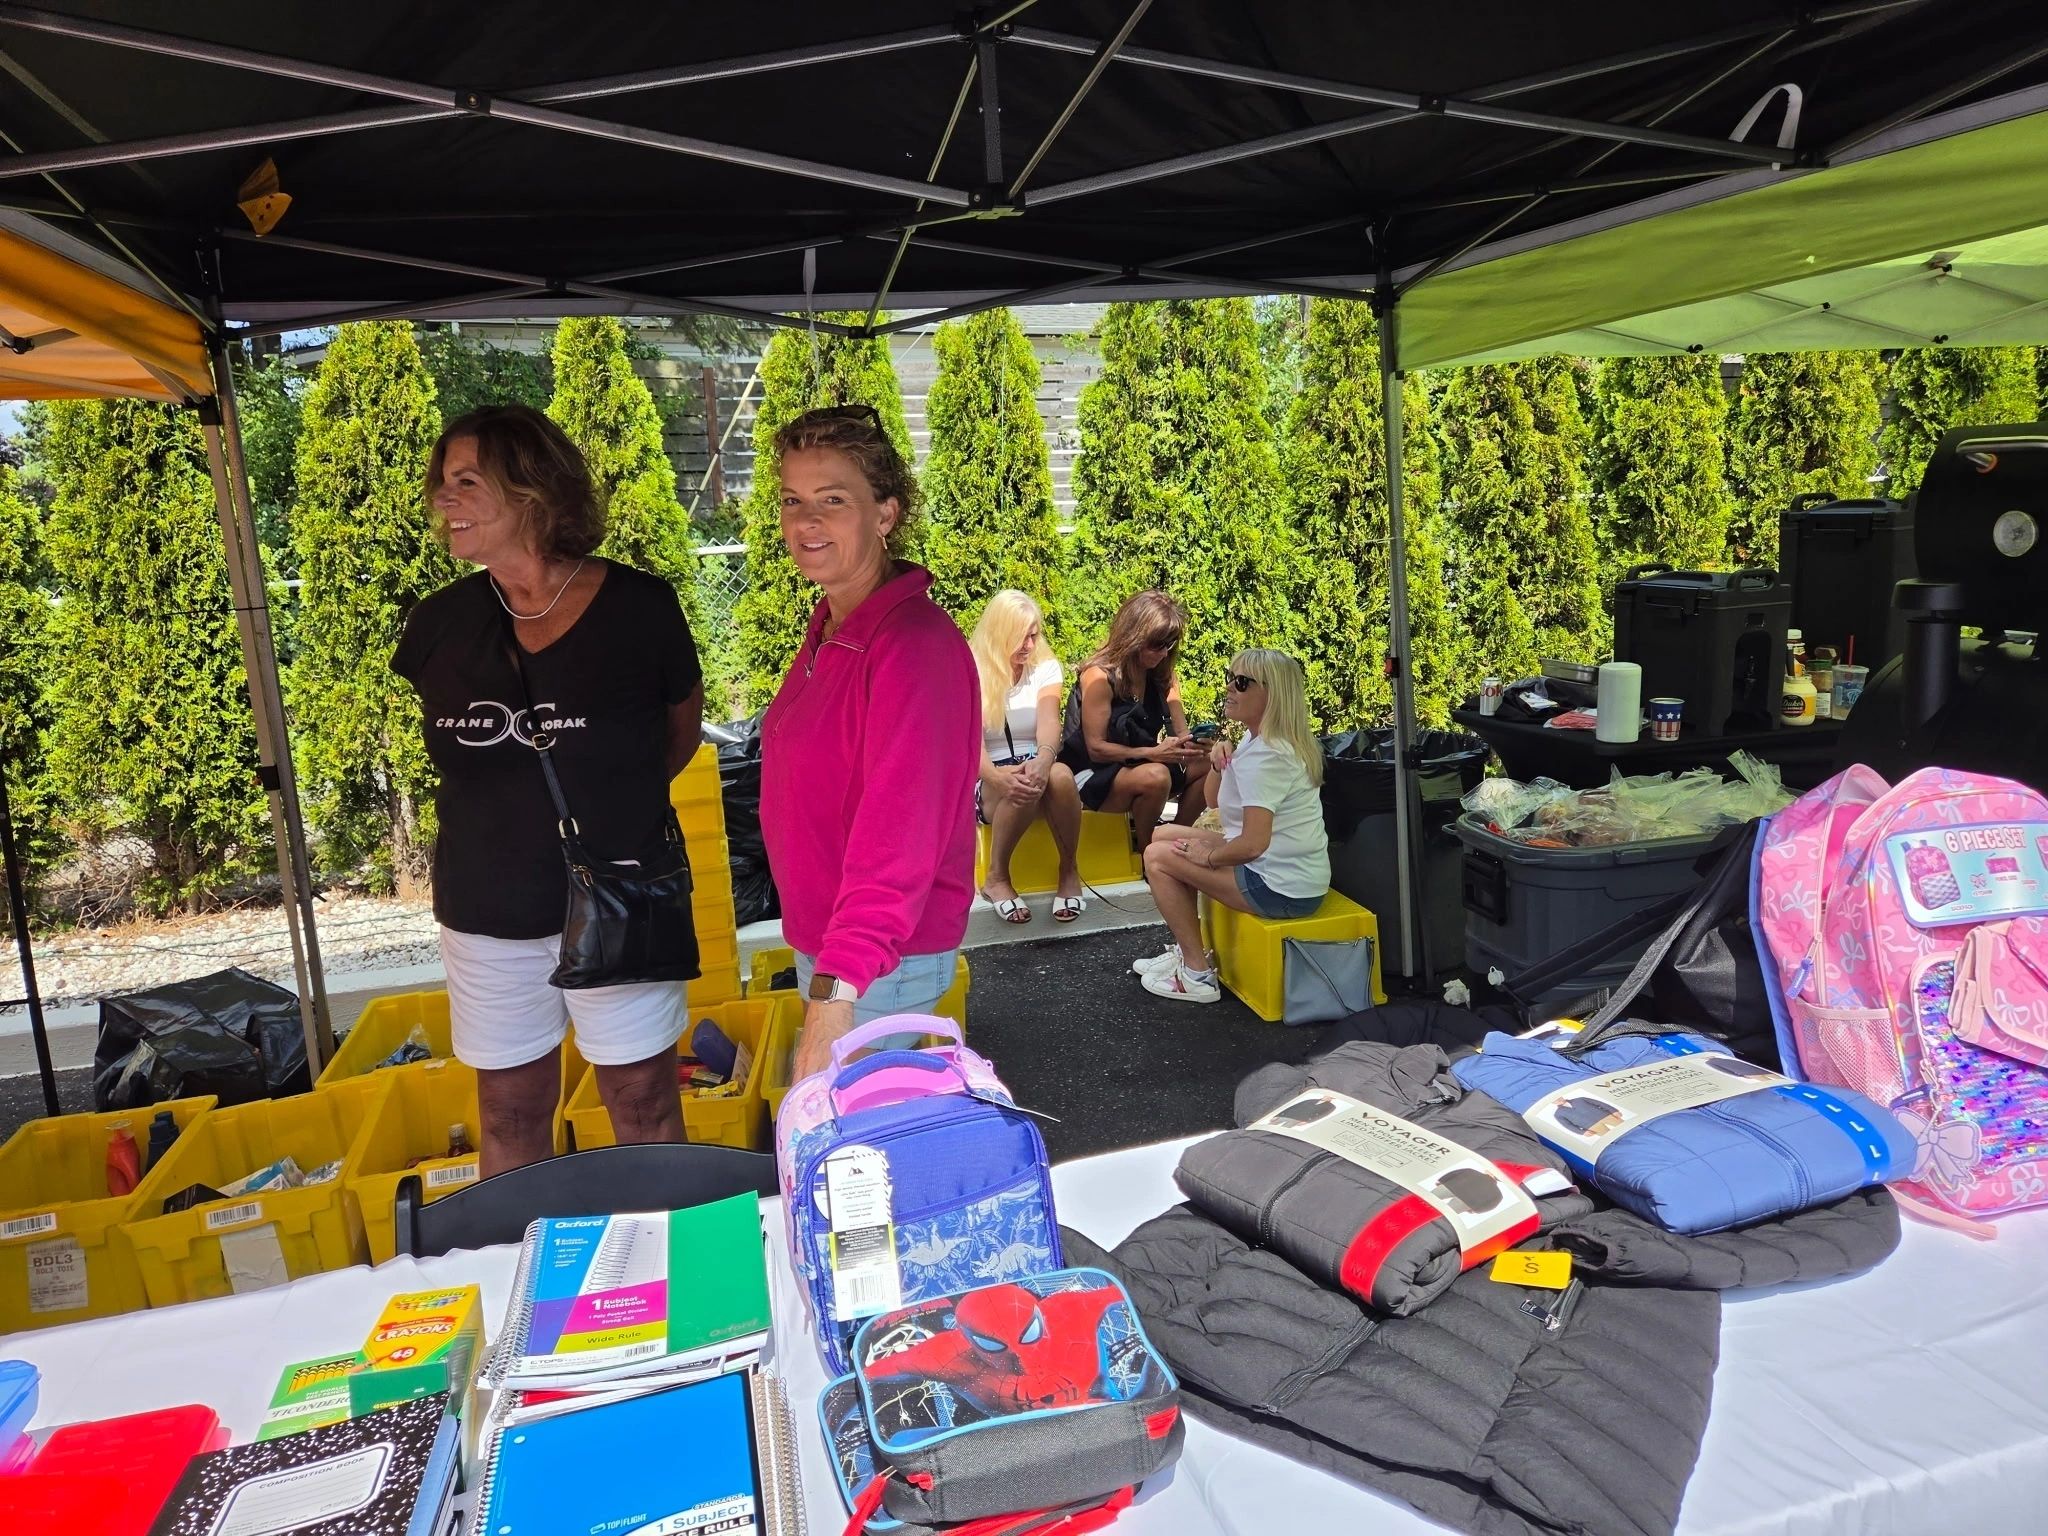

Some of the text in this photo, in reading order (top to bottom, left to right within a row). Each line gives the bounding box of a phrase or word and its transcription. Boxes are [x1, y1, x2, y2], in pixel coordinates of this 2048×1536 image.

[1481, 683, 1503, 697] Cok
[435, 718, 494, 728] CRANE
[1944, 826, 2027, 853] 6 PIECE SET
[1595, 1065, 1685, 1089] VOYAGER
[1614, 1086, 1640, 1098] LINED
[1362, 1111, 1452, 1156] VOYAGER
[1825, 1103, 1842, 1113] L
[1849, 1120, 1866, 1132] L
[1869, 1144, 1882, 1158] L
[1340, 1119, 1368, 1132] LINED
[1368, 1130, 1402, 1149] PUFFER
[1402, 1147, 1438, 1164] JACKET
[1349, 1117, 1376, 1131] MEN'S
[1379, 1129, 1408, 1145] POLAR
[1408, 1143, 1442, 1160] FLEECE
[33, 1254, 73, 1268] BDL3
[1523, 1262, 1540, 1274] S
[400, 1291, 467, 1303] Crayola
[592, 1296, 638, 1311] 1 Subject
[603, 1299, 647, 1310] Notebook
[374, 1323, 453, 1342] CRAYONS
[709, 1317, 758, 1338] Oxford
[586, 1332, 641, 1344] Wide Rule
[390, 1347, 416, 1360] 48
[258, 1457, 366, 1489] COMPOSITION BOOK
[656, 1522, 665, 1533] 1
[703, 1515, 751, 1535] RULE
